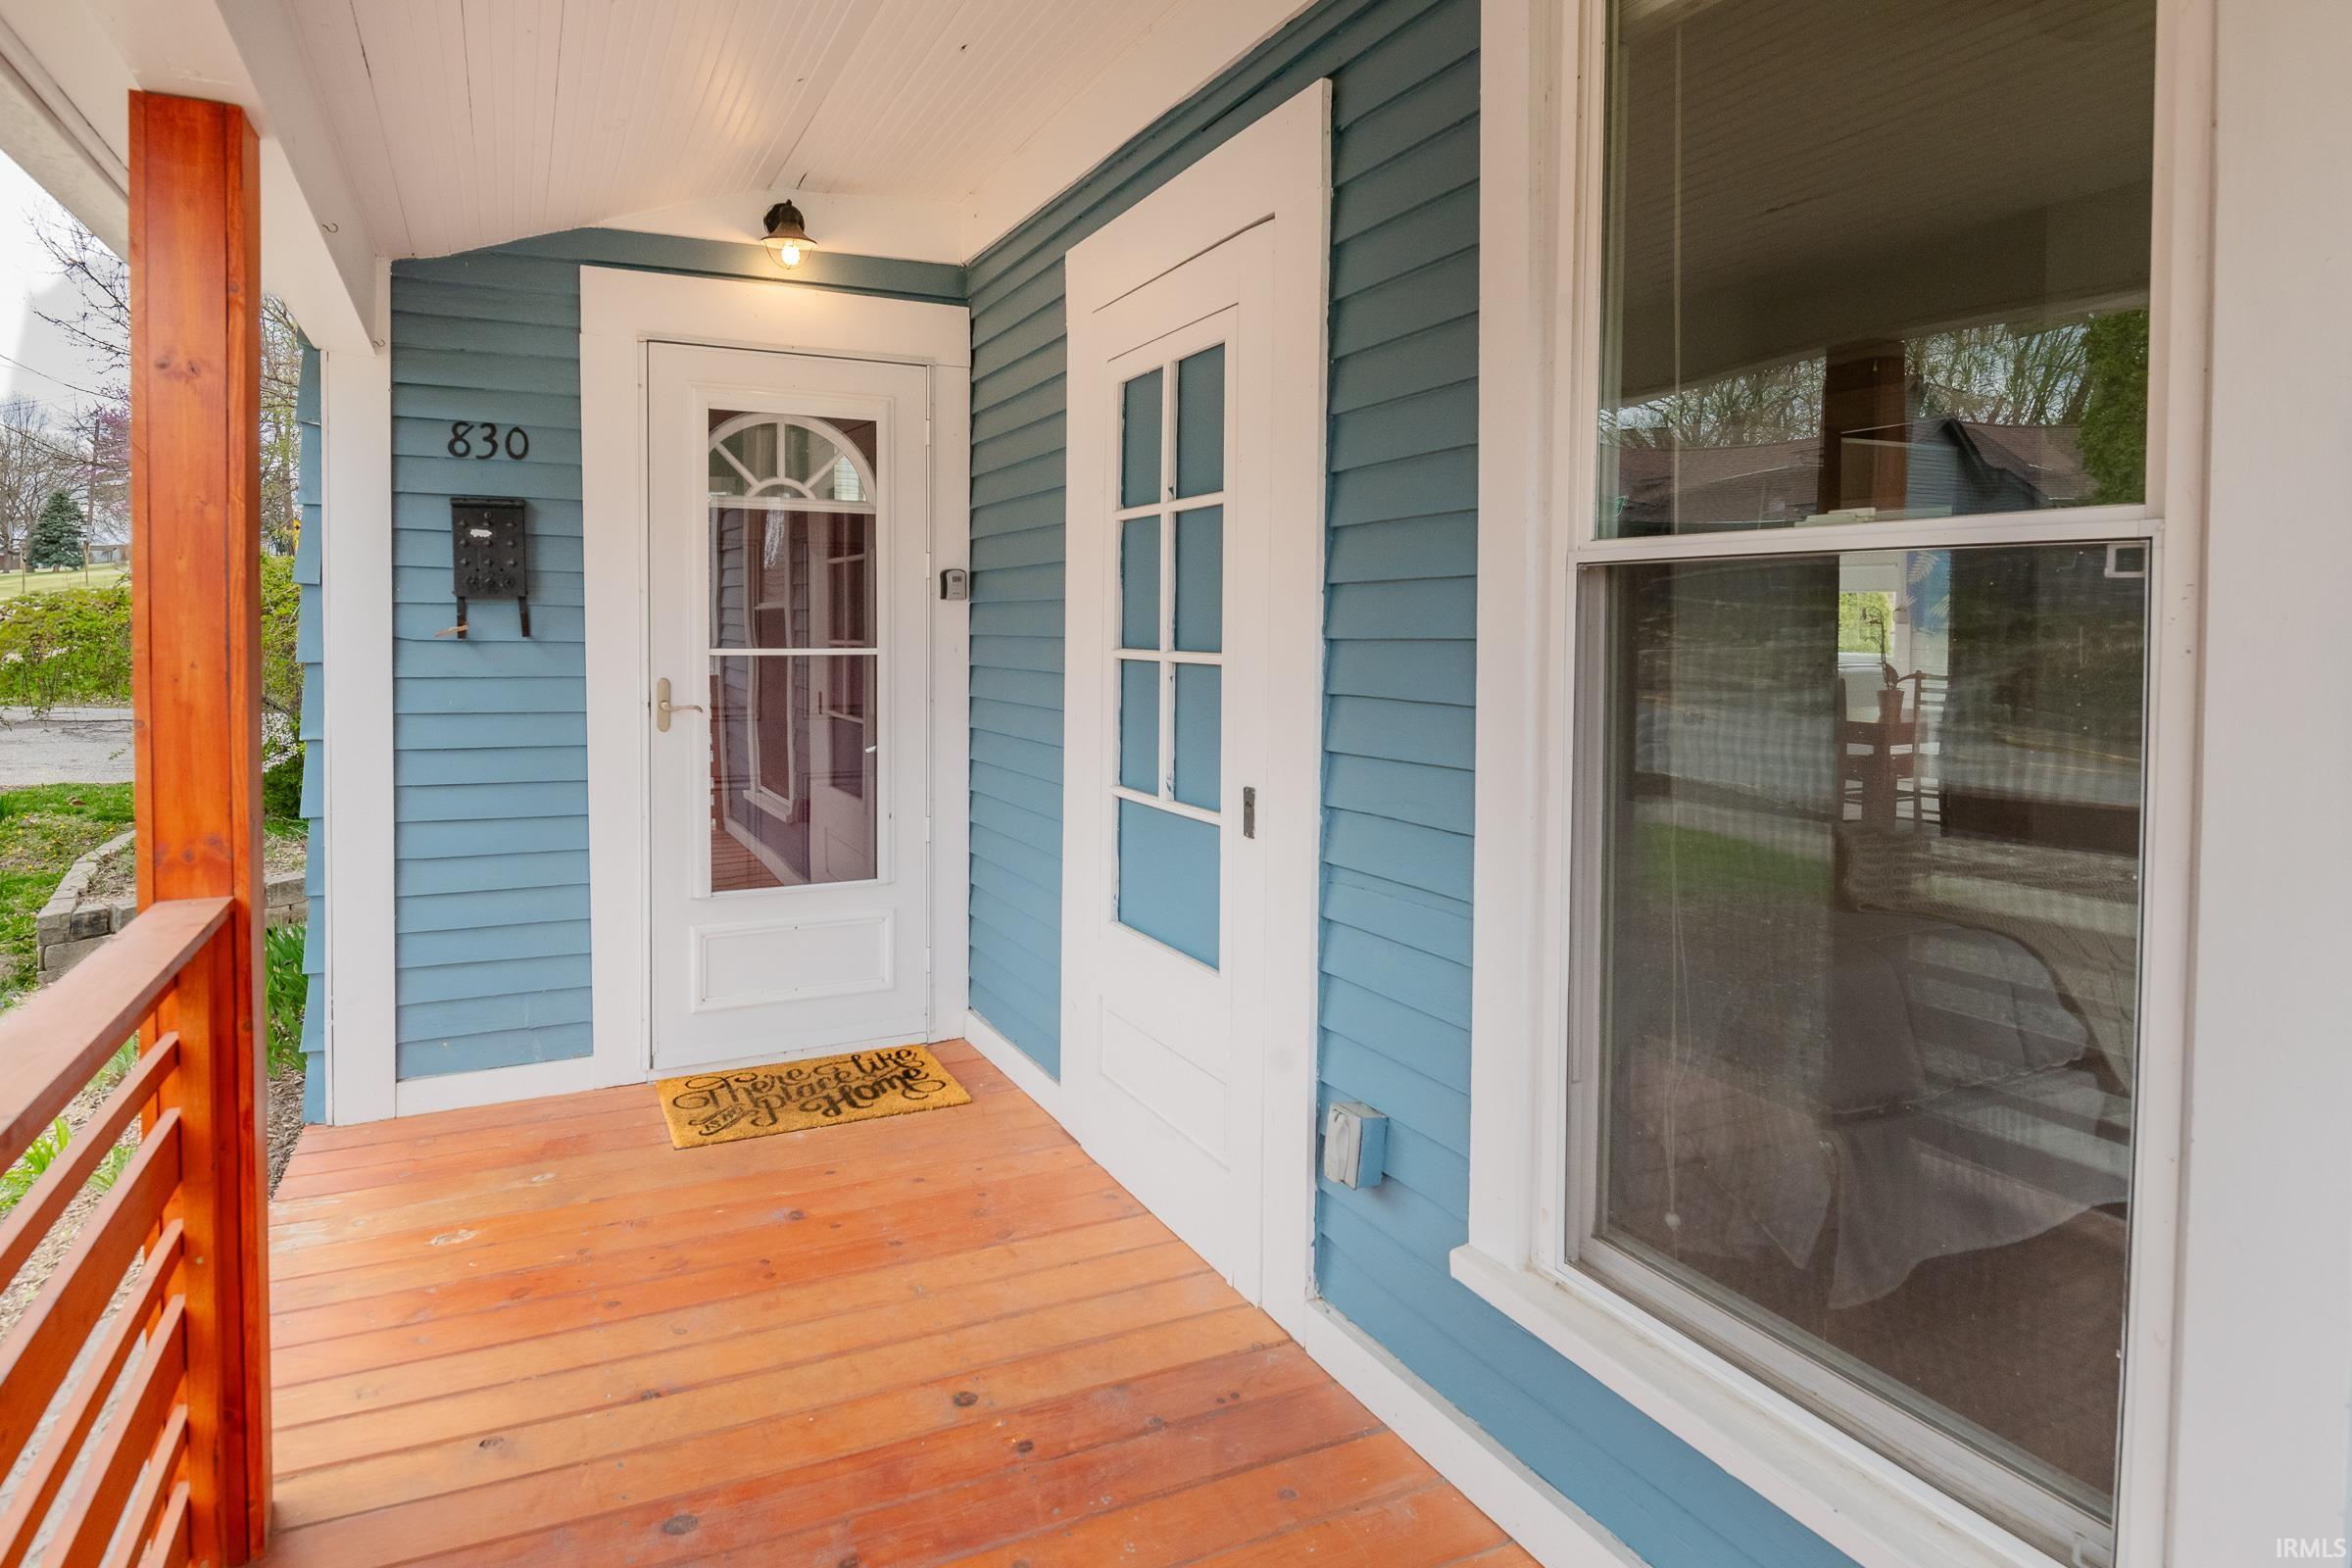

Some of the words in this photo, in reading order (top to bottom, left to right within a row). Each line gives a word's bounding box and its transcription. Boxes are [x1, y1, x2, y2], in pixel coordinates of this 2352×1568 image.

[448, 420, 529, 460] 830
[833, 1049, 925, 1076] like
[673, 1065, 811, 1109] There
